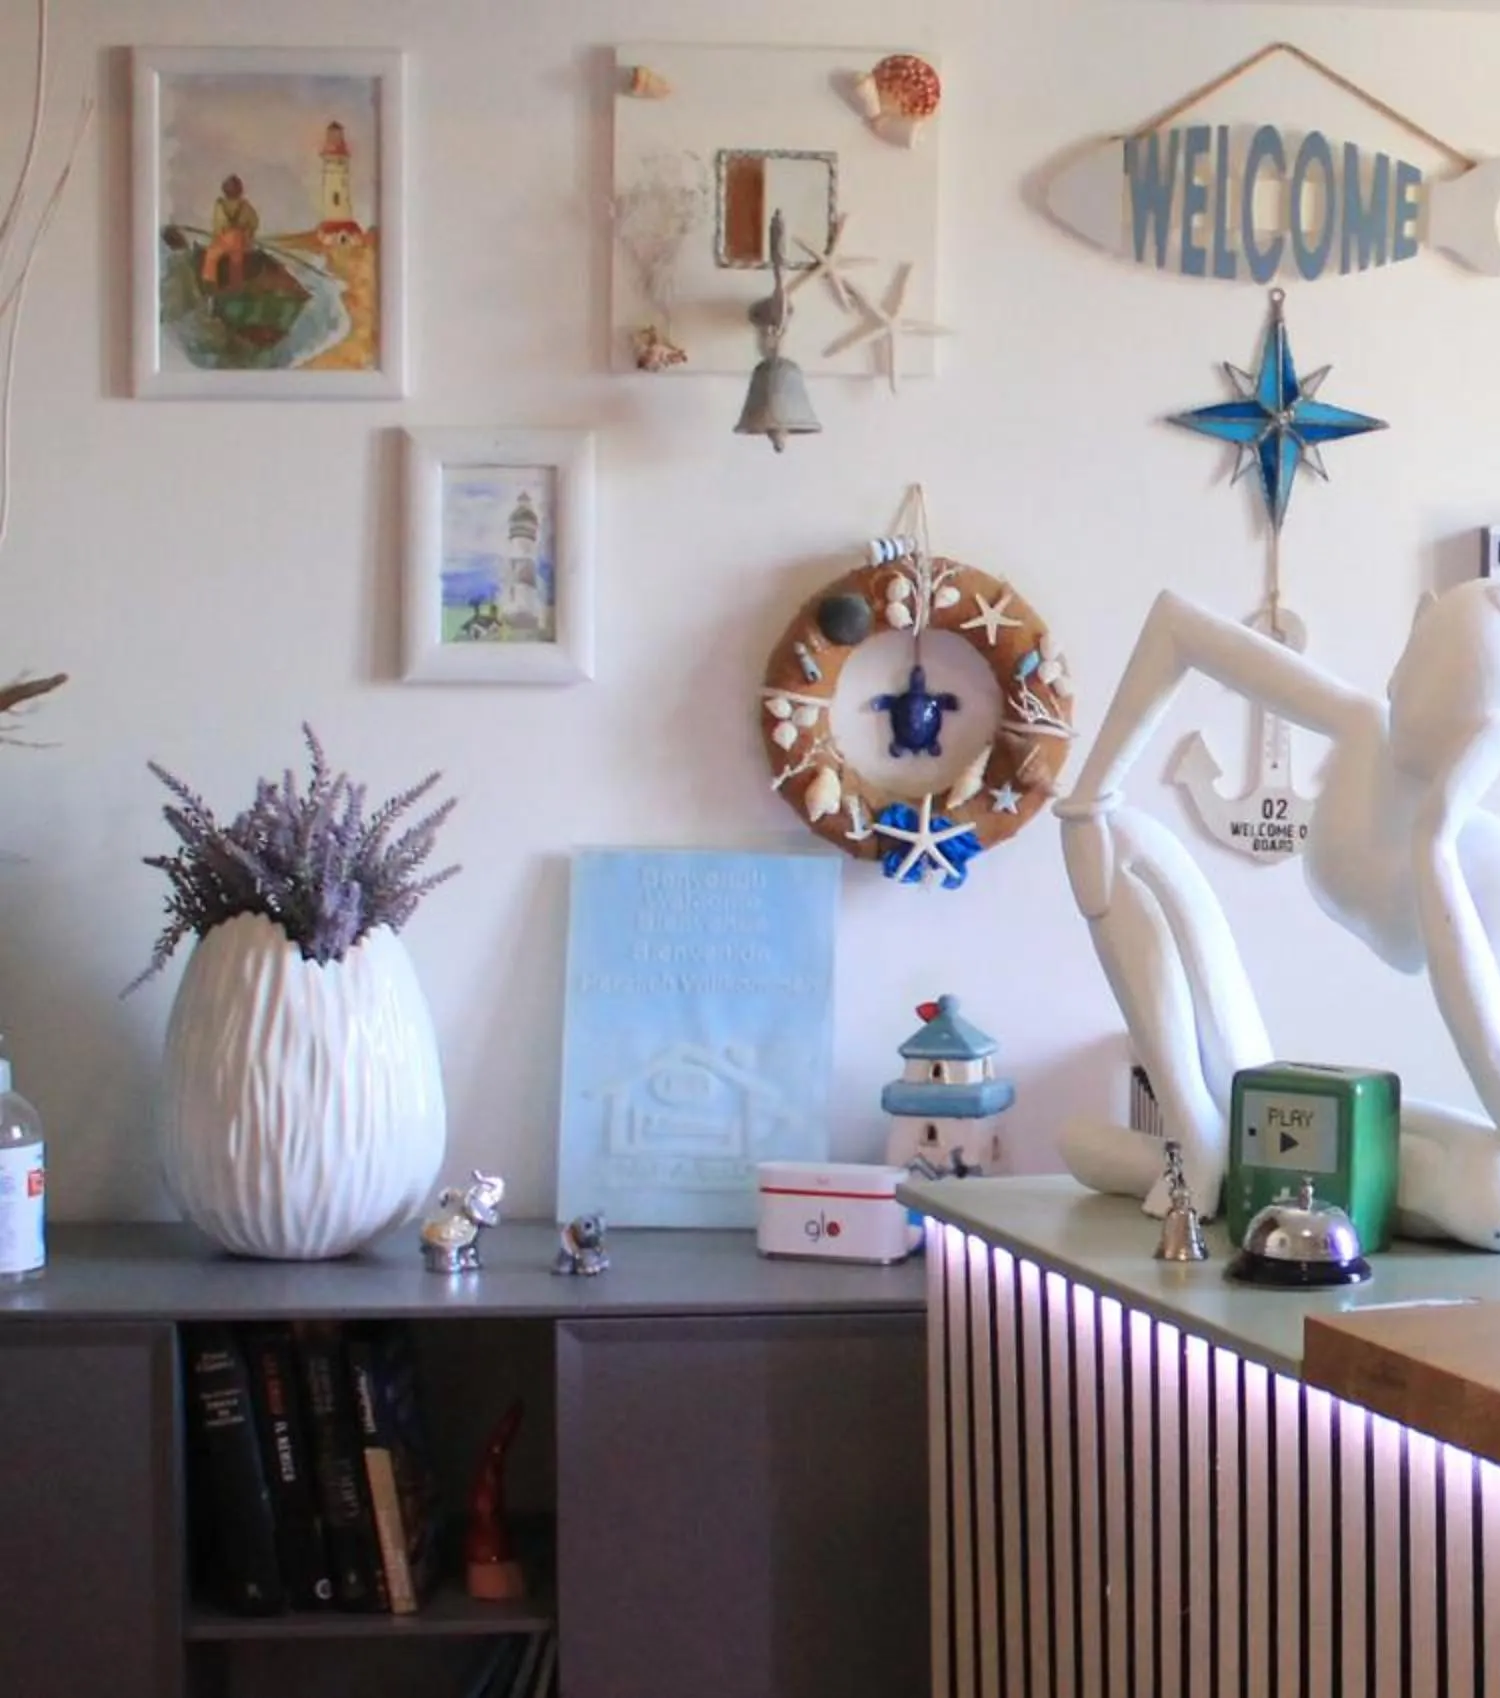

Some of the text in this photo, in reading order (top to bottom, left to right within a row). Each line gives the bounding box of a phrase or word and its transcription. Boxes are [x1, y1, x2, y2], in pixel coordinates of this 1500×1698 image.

[1123, 124, 1422, 285] WELCOME
[1262, 798, 1288, 820] 02
[1231, 821, 1295, 838] WELCOME
[1267, 1107, 1315, 1127] PLAY
[804, 1208, 841, 1243] glo
